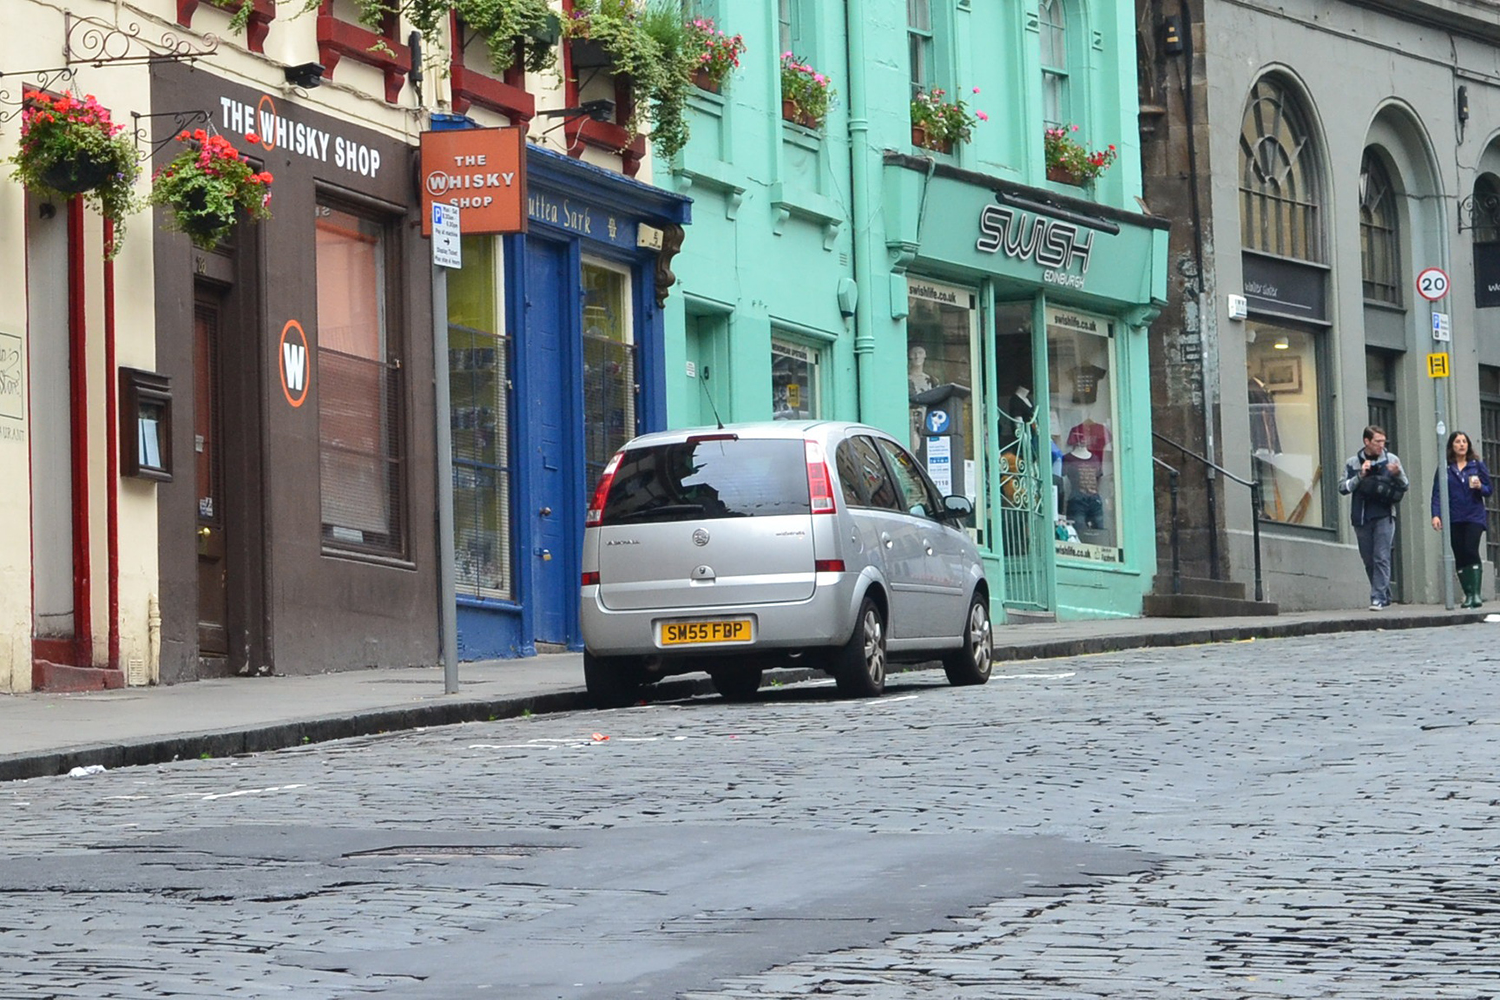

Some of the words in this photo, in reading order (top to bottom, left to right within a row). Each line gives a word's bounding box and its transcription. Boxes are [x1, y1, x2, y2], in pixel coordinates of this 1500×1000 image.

[220, 96, 255, 134] THE
[259, 109, 331, 162] WHISKY
[334, 136, 381, 179] SHOP
[454, 154, 487, 167] THE
[429, 172, 515, 190] WHISKY
[449, 196, 493, 209] SHOP
[528, 194, 557, 222] uttea
[563, 199, 591, 234] Sark
[977, 204, 1094, 274] SWISH
[1043, 269, 1086, 289] EDINBURGH
[1422, 277, 1445, 291] 20
[909, 285, 956, 304] swishlife.co.uk
[1054, 313, 1097, 332] swishlife.co.uk
[283, 342, 305, 391] W
[1055, 544, 1091, 559] wishlife.co.uk
[667, 623, 708, 641] SM55
